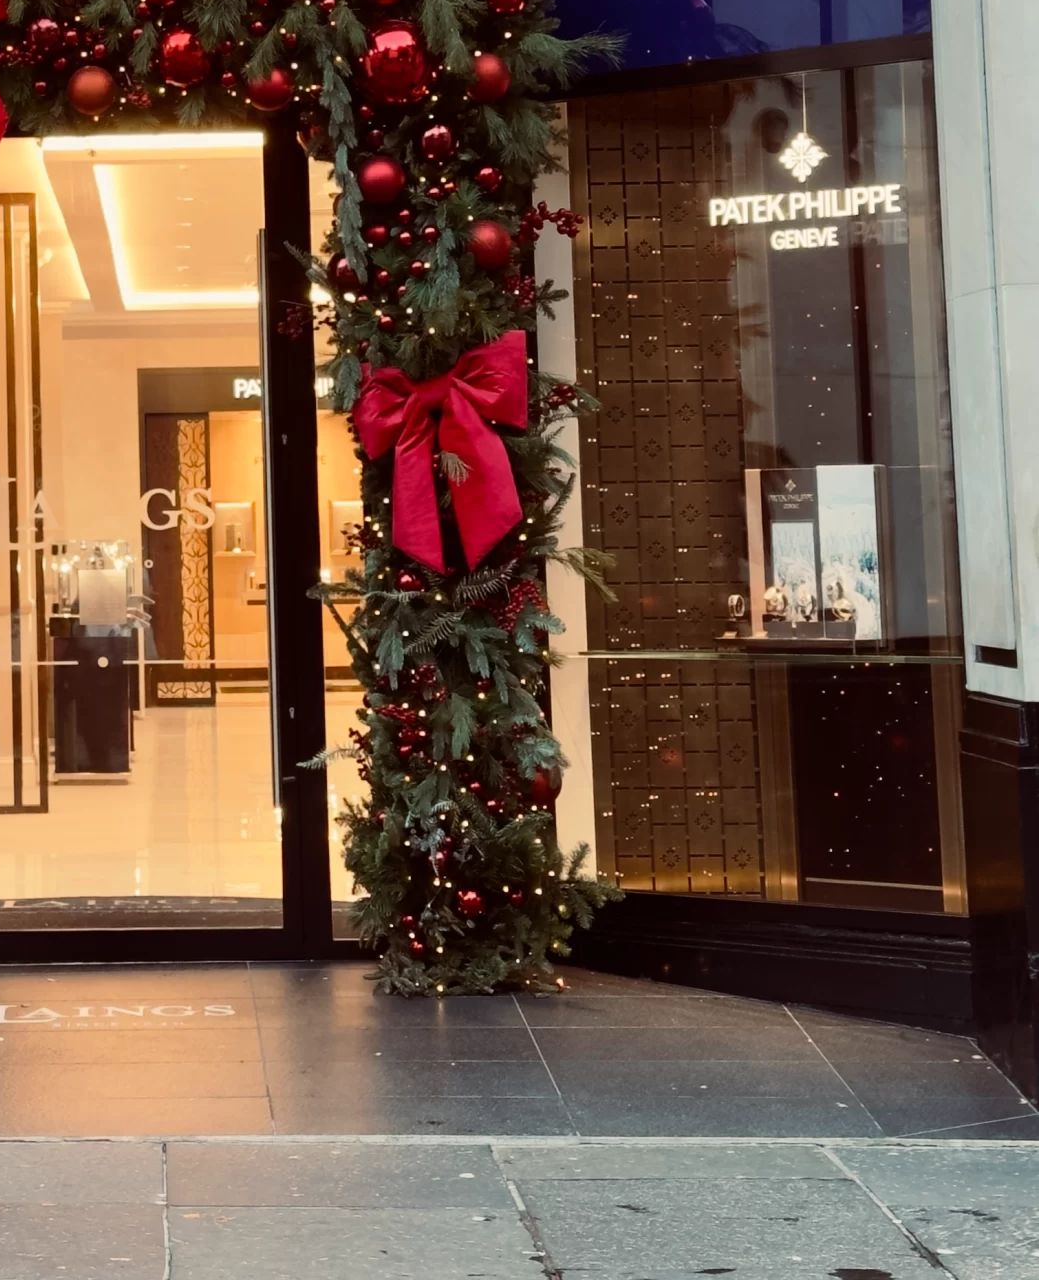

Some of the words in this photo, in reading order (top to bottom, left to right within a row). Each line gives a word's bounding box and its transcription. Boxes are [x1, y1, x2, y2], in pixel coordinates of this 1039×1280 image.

[709, 193, 788, 227] PATEK
[789, 183, 902, 220] PHILIPPE
[770, 226, 840, 251] GENEVE
